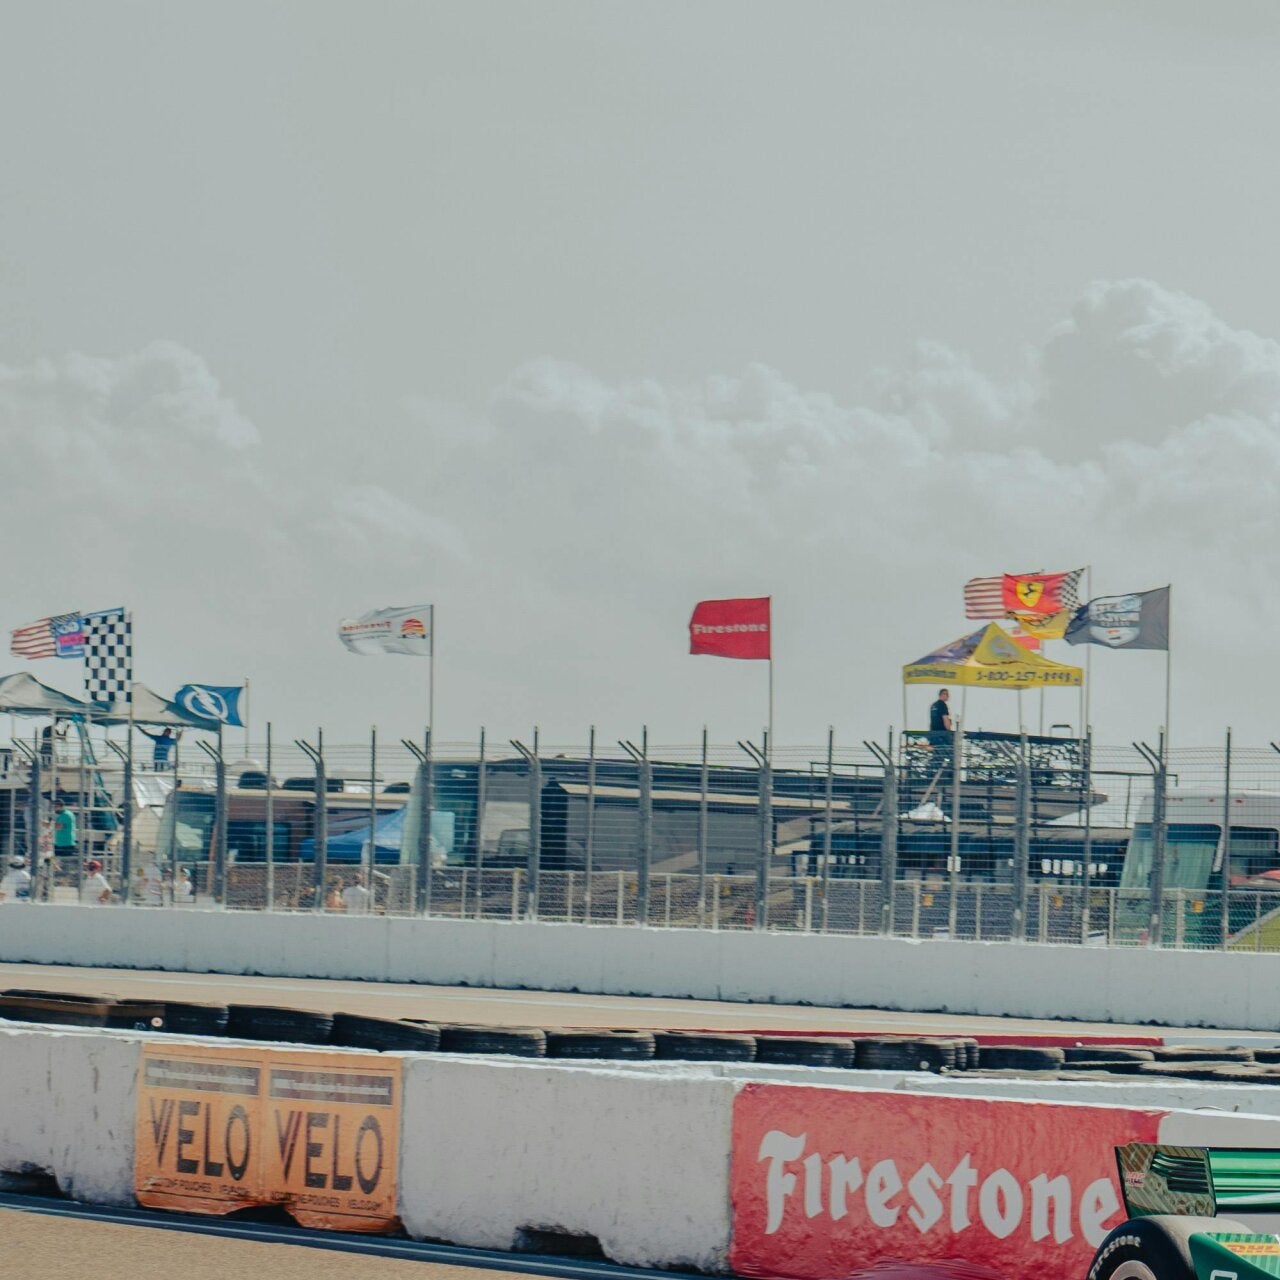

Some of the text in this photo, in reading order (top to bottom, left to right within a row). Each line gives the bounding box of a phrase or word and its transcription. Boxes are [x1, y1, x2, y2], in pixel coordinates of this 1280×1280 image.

[692, 623, 768, 636] Firestone
[150, 1098, 250, 1181] VELO
[275, 1109, 384, 1195] VELO
[757, 1129, 1121, 1249] Firestone
